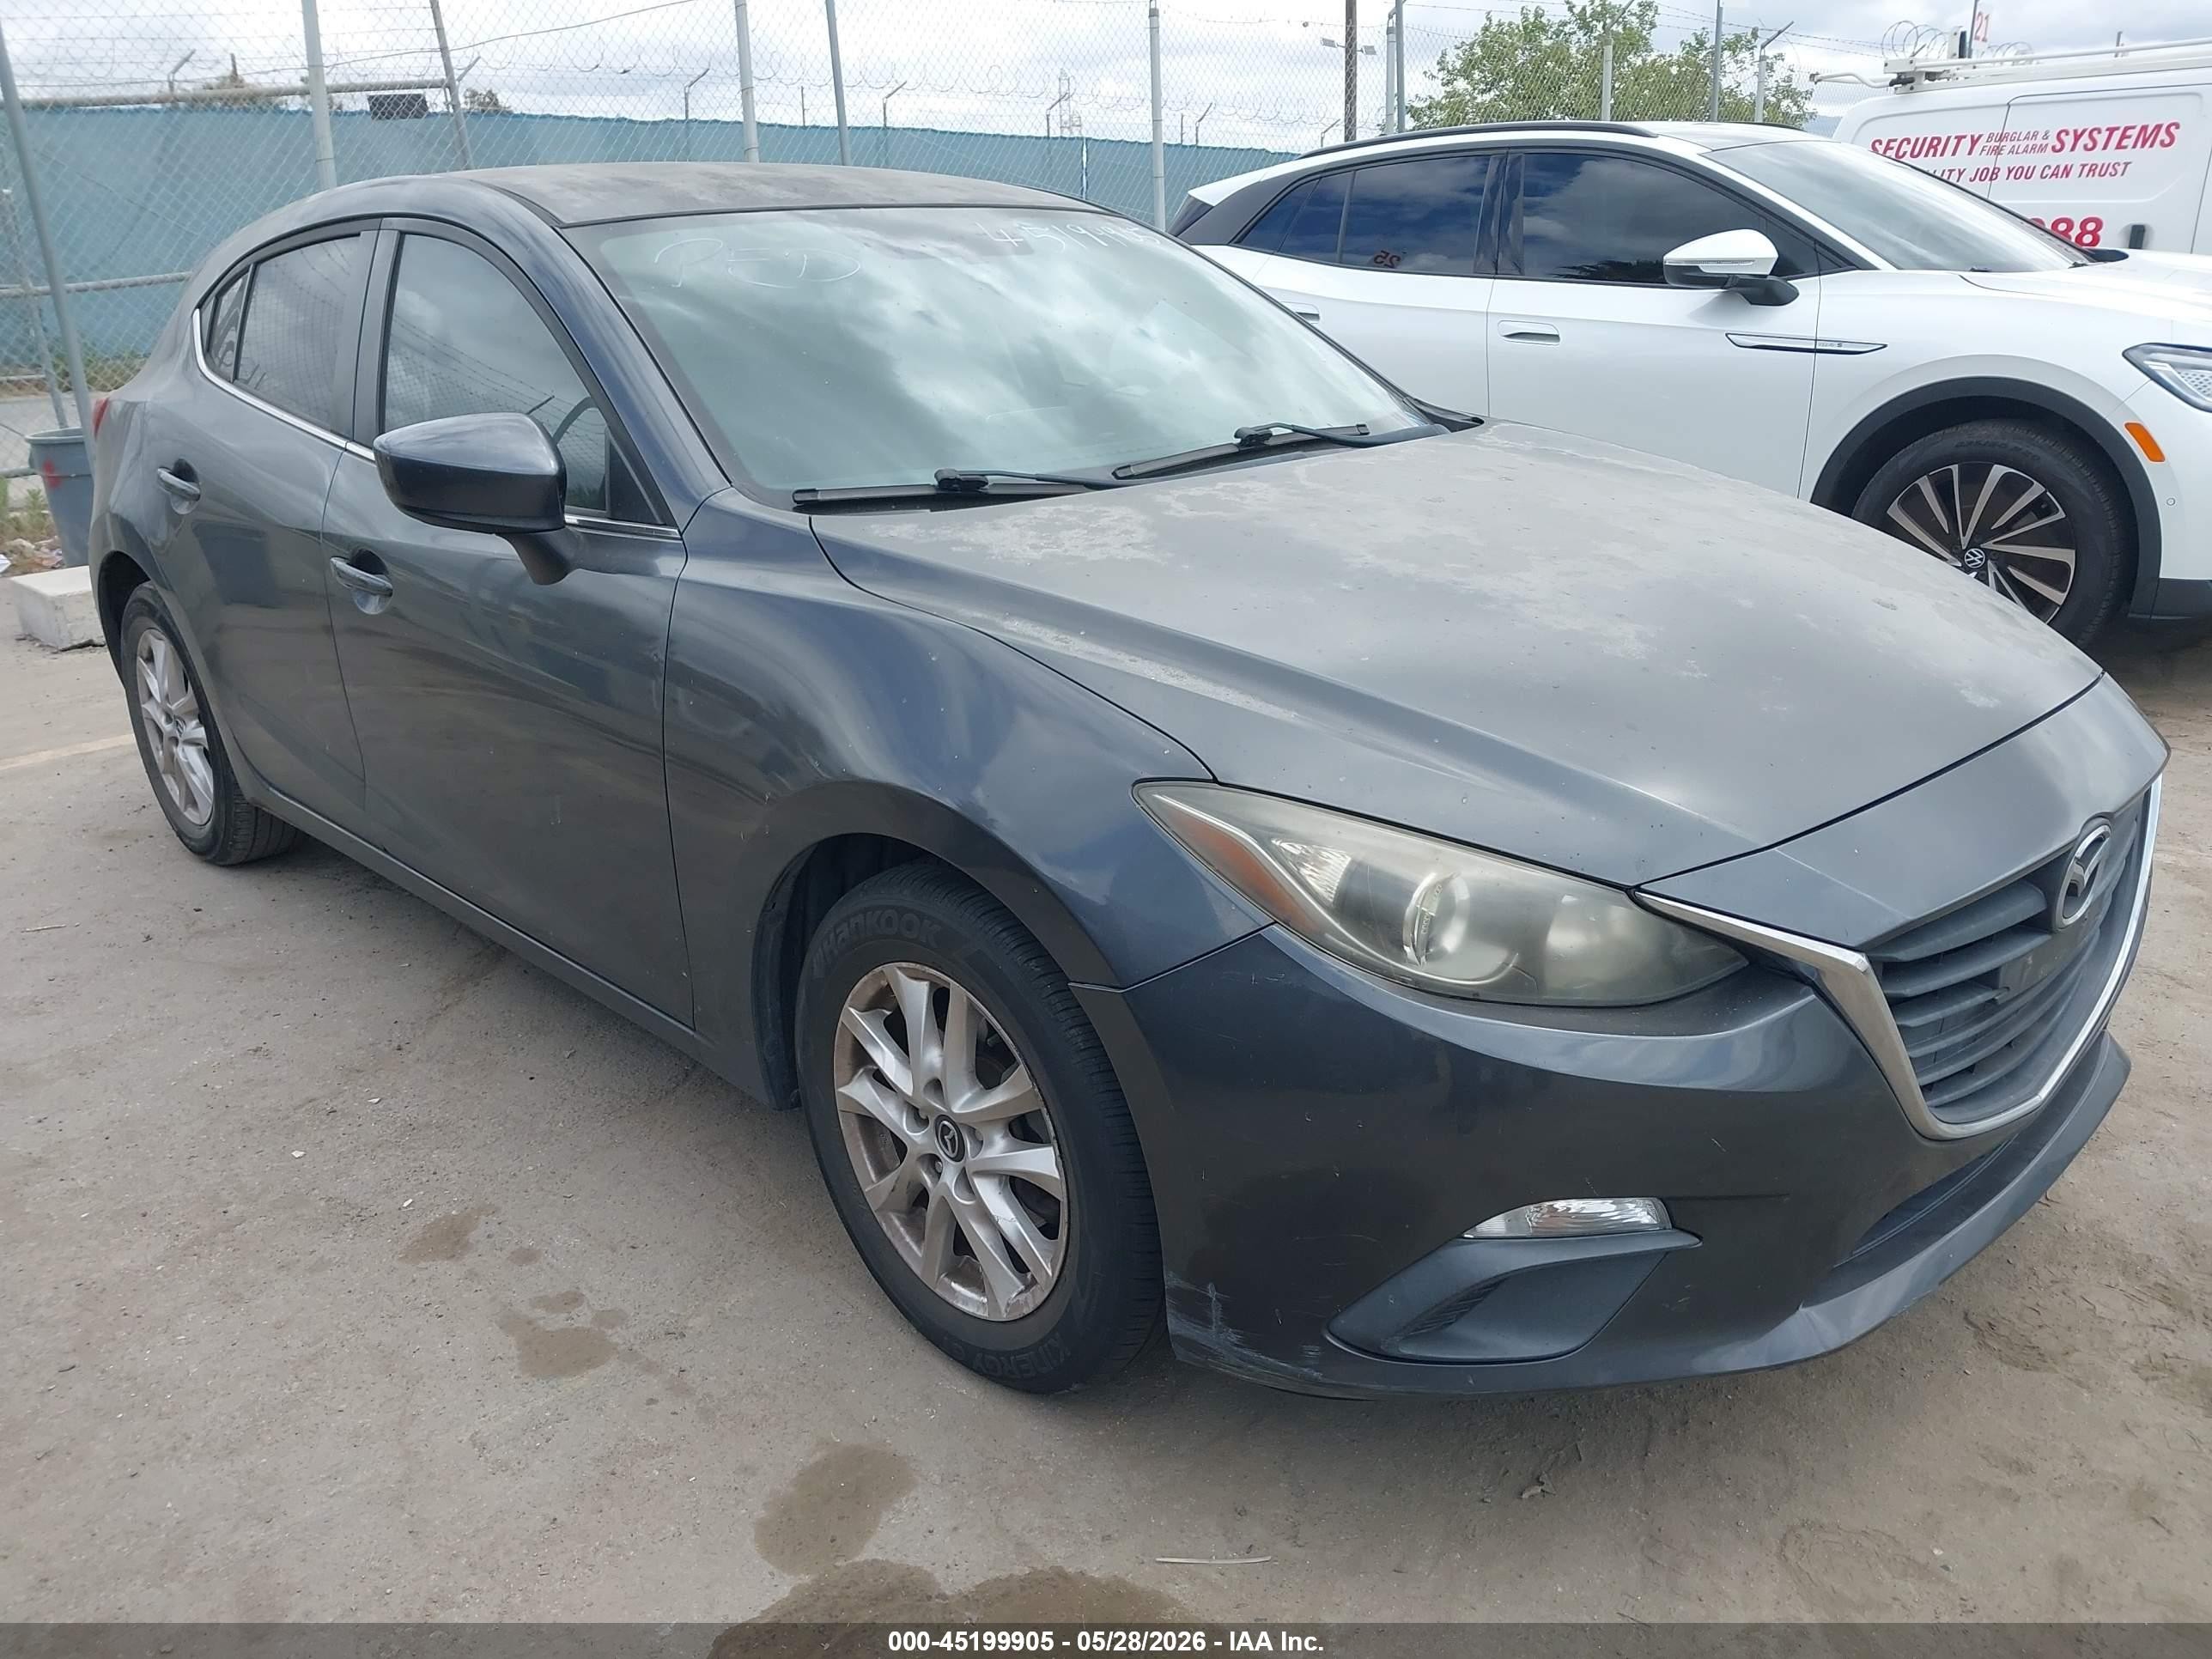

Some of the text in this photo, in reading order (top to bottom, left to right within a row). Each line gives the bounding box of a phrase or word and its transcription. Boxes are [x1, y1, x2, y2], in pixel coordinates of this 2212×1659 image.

[1973, 11, 1990, 43] 21
[1870, 134, 1984, 160] SECURITY
[1986, 130, 2051, 143] BURGLAR &
[2051, 121, 2180, 155] SYSTEMS
[1979, 143, 2050, 156] FIRE ALARM
[1969, 166, 2001, 183] JOB
[2006, 165, 2036, 181] YOU
[2040, 164, 2075, 179] CAN
[2078, 161, 2132, 179] TRUST
